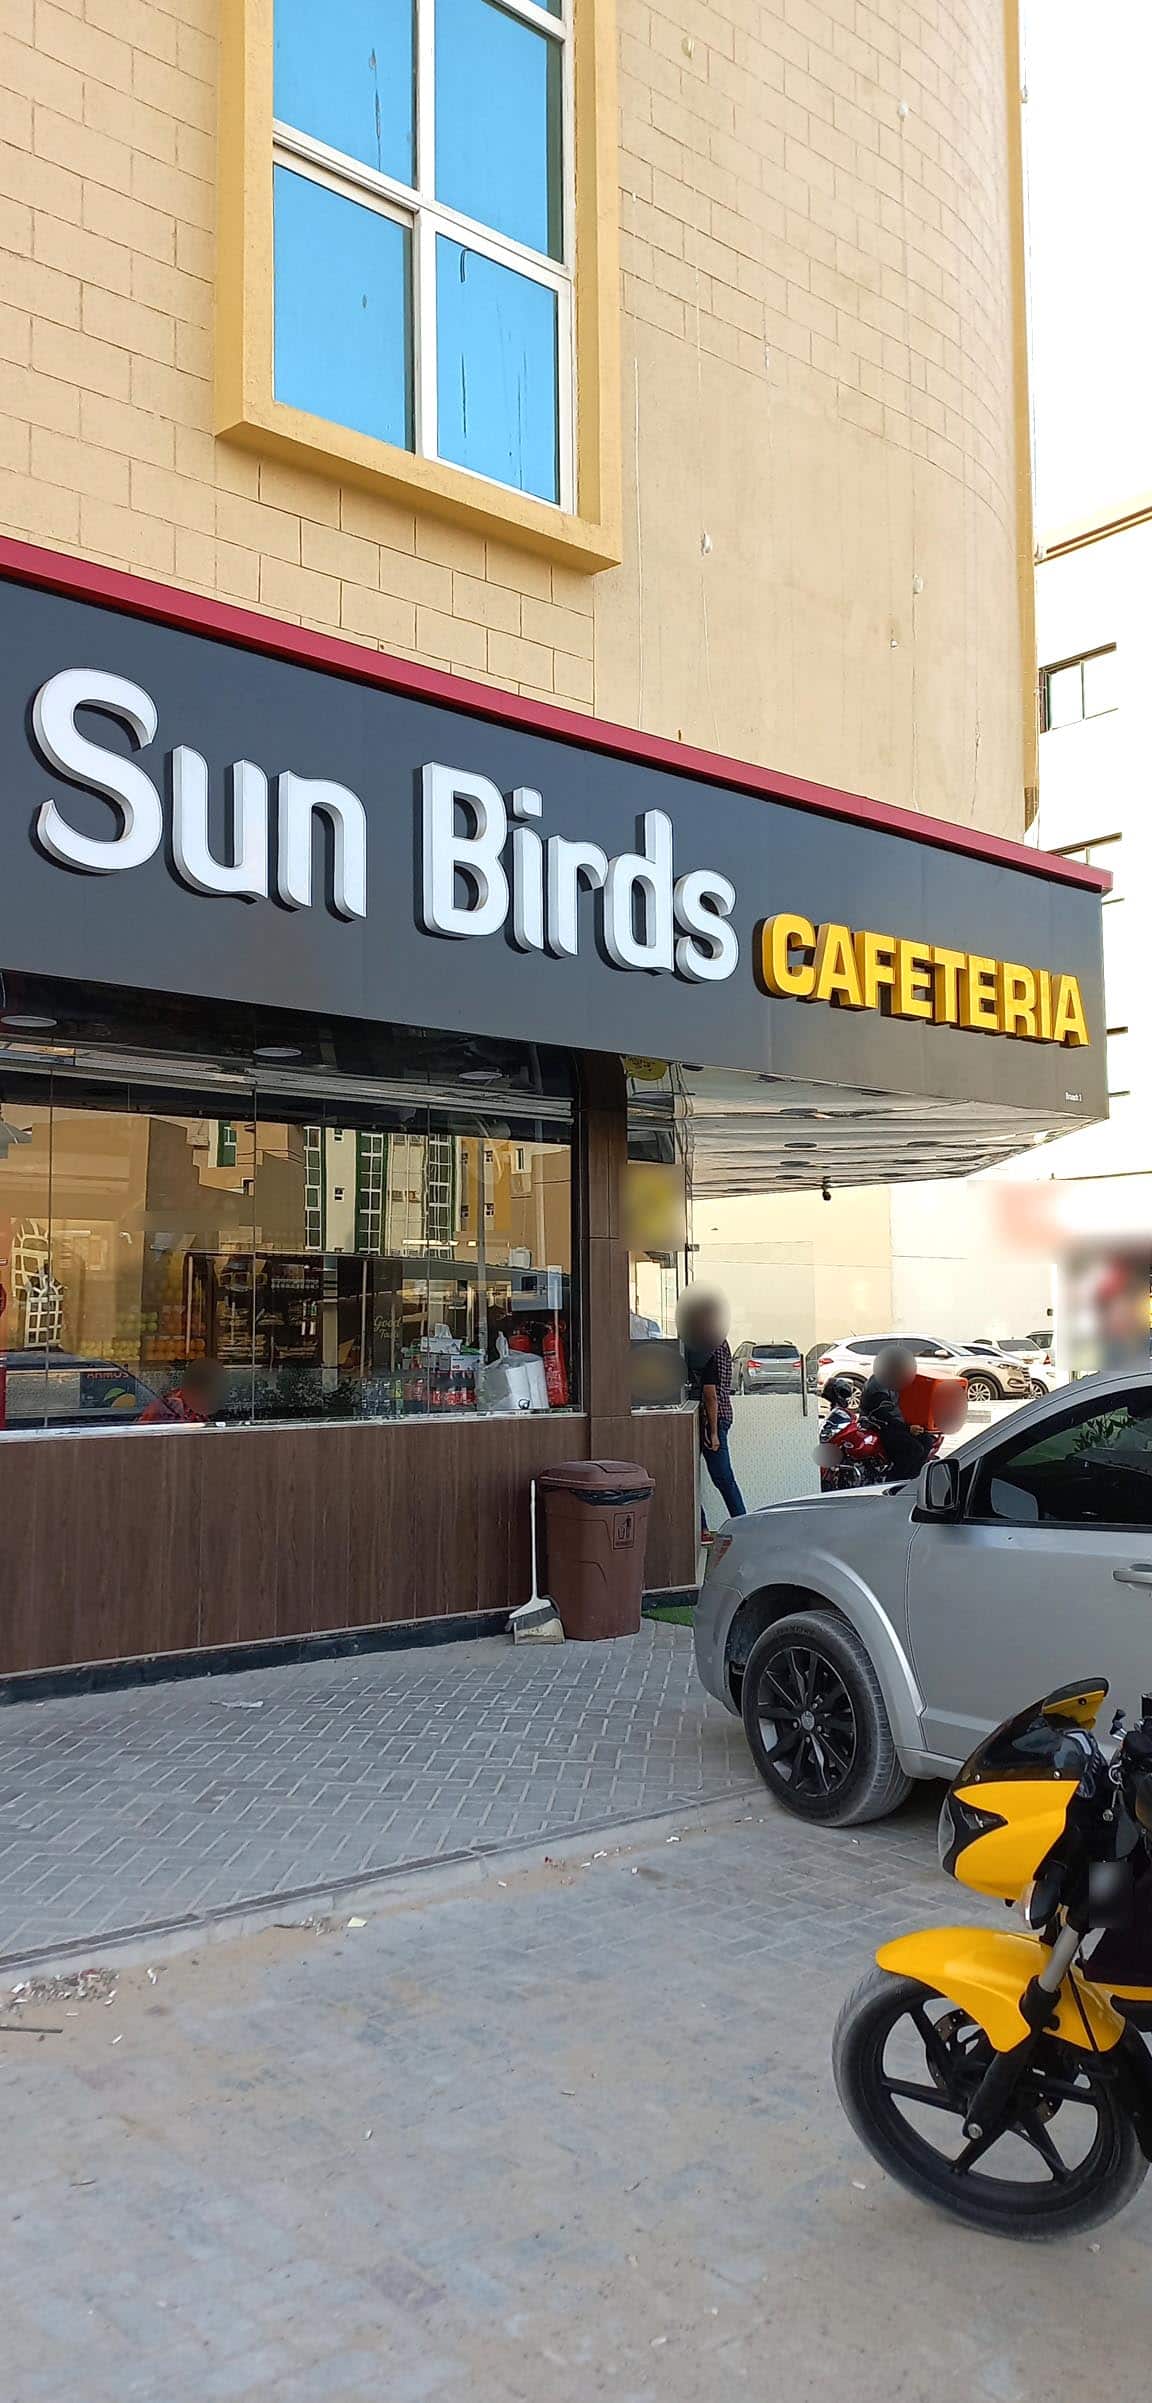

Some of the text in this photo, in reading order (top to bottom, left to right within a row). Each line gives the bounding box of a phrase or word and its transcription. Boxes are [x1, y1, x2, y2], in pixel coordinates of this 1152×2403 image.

[32, 667, 1090, 1047] Sun Birds CAFETERIA
